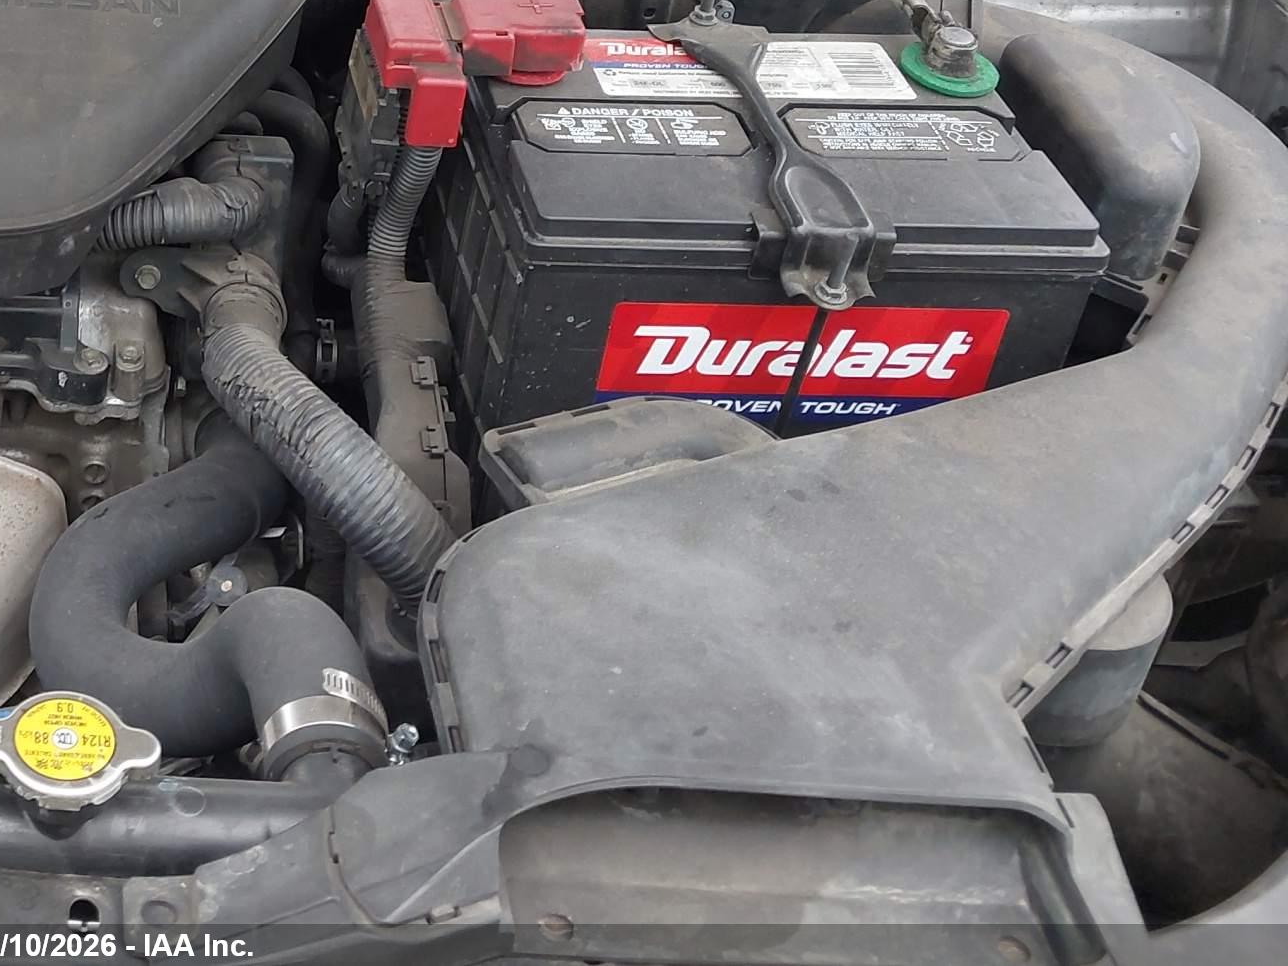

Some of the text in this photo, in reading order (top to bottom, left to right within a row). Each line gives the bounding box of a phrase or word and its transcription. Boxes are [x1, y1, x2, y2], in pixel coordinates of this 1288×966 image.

[599, 42, 688, 56] Durala
[571, 107, 629, 116] DANGER
[642, 108, 695, 117] POISON
[633, 325, 969, 380] Duralast
[696, 399, 897, 415] OVEN TOUGH
[34, 731, 49, 745] 88
[82, 734, 111, 748] R124
